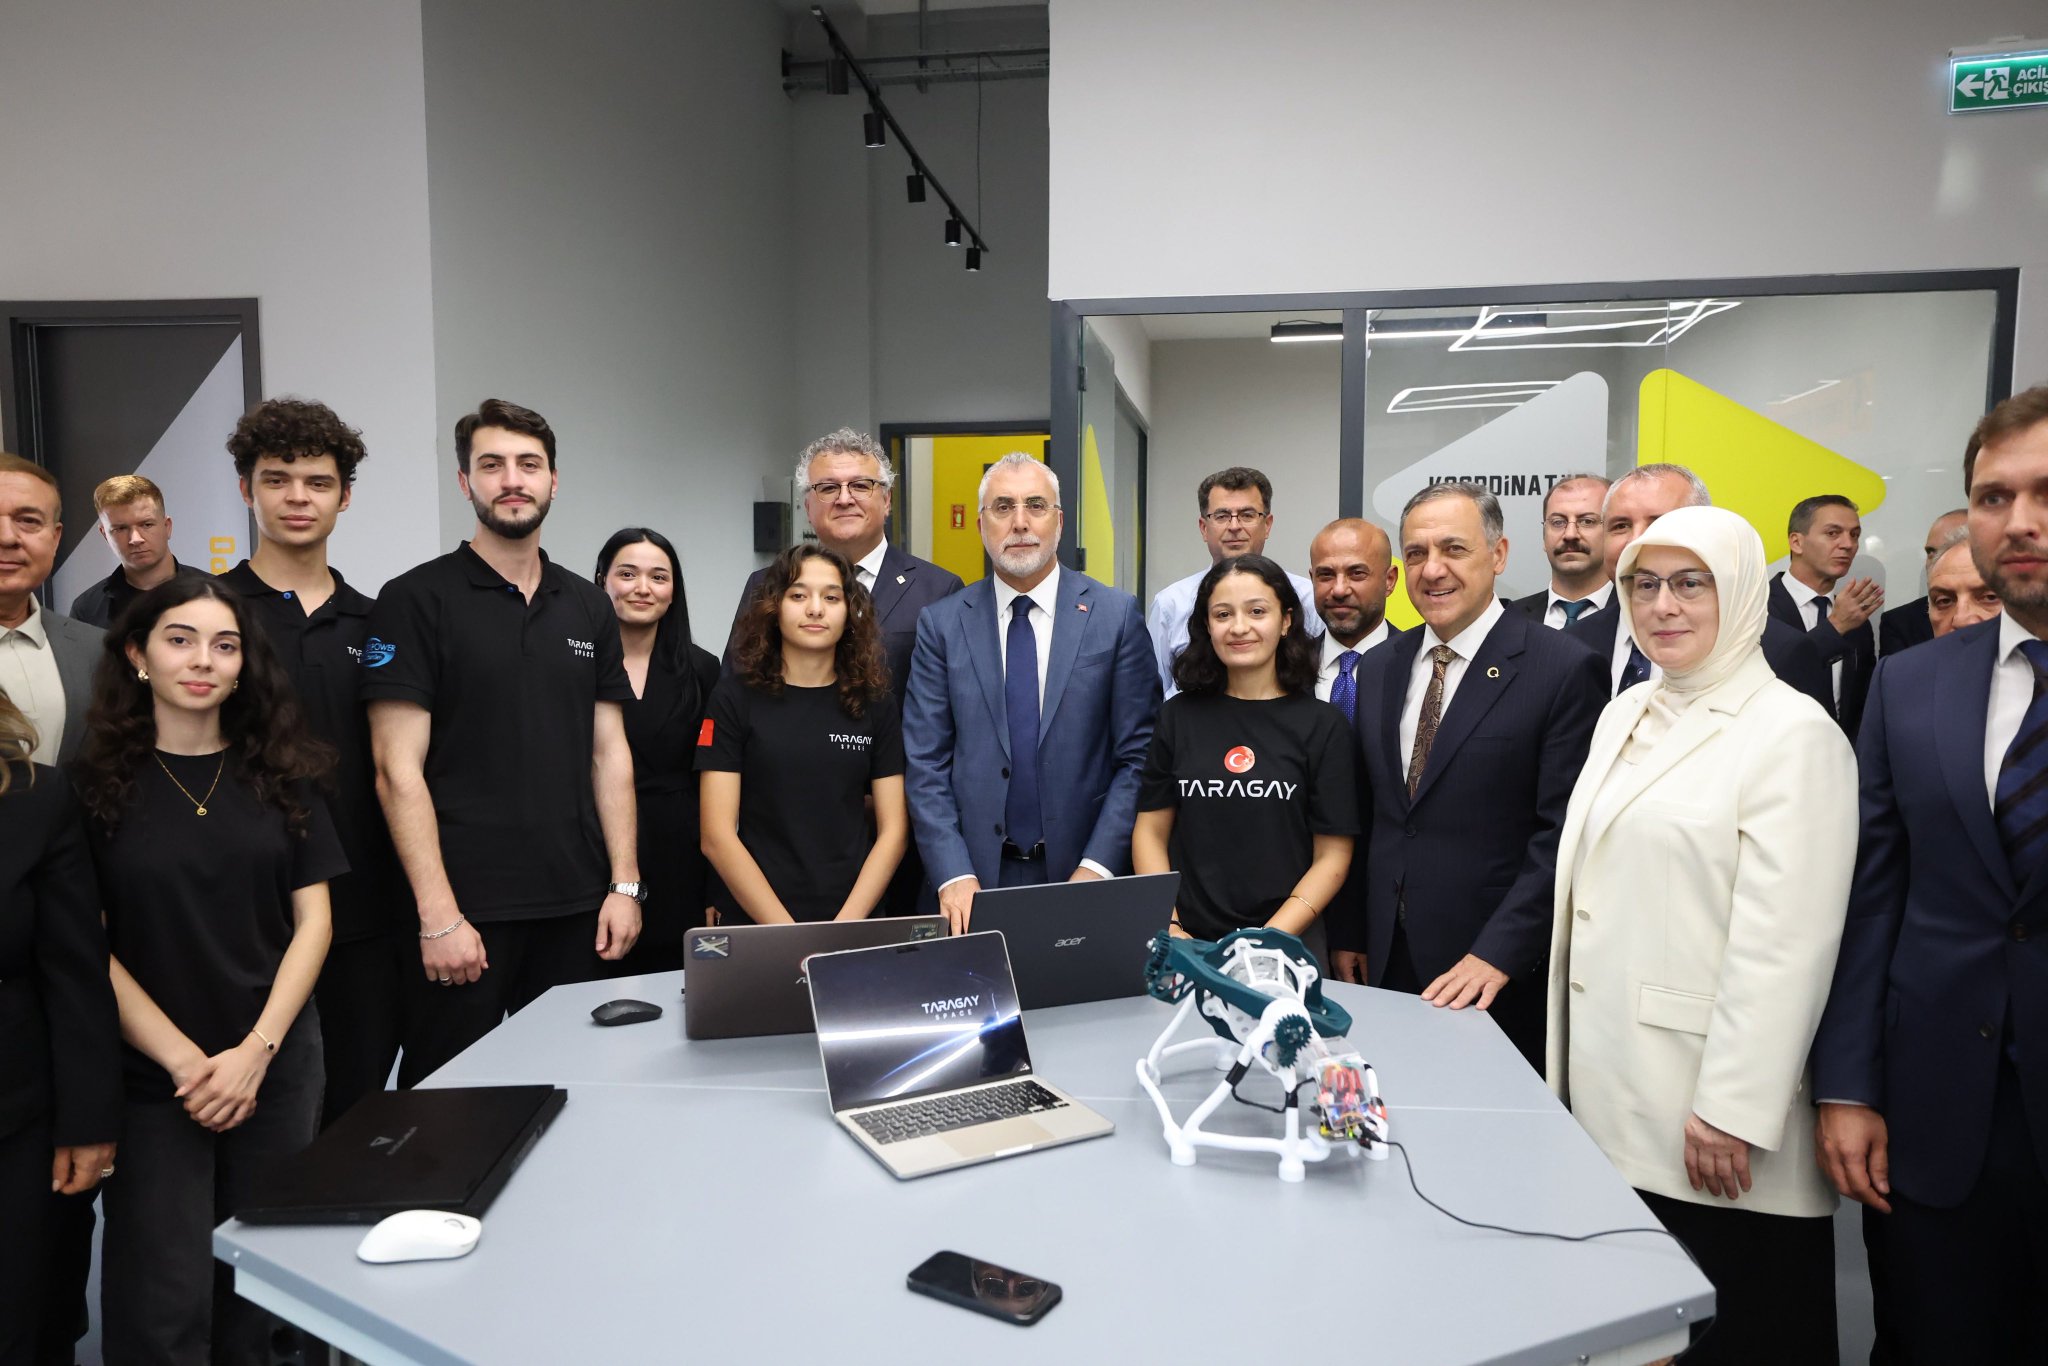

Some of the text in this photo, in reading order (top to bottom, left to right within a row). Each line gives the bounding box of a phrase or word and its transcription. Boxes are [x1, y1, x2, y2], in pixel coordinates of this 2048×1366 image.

[828, 733, 873, 745] TARAGAY
[1178, 779, 1298, 800] TARAGAY
[1054, 936, 1087, 948] acer
[921, 994, 979, 1015] TARAGAY
[935, 1008, 973, 1021] SPACE
